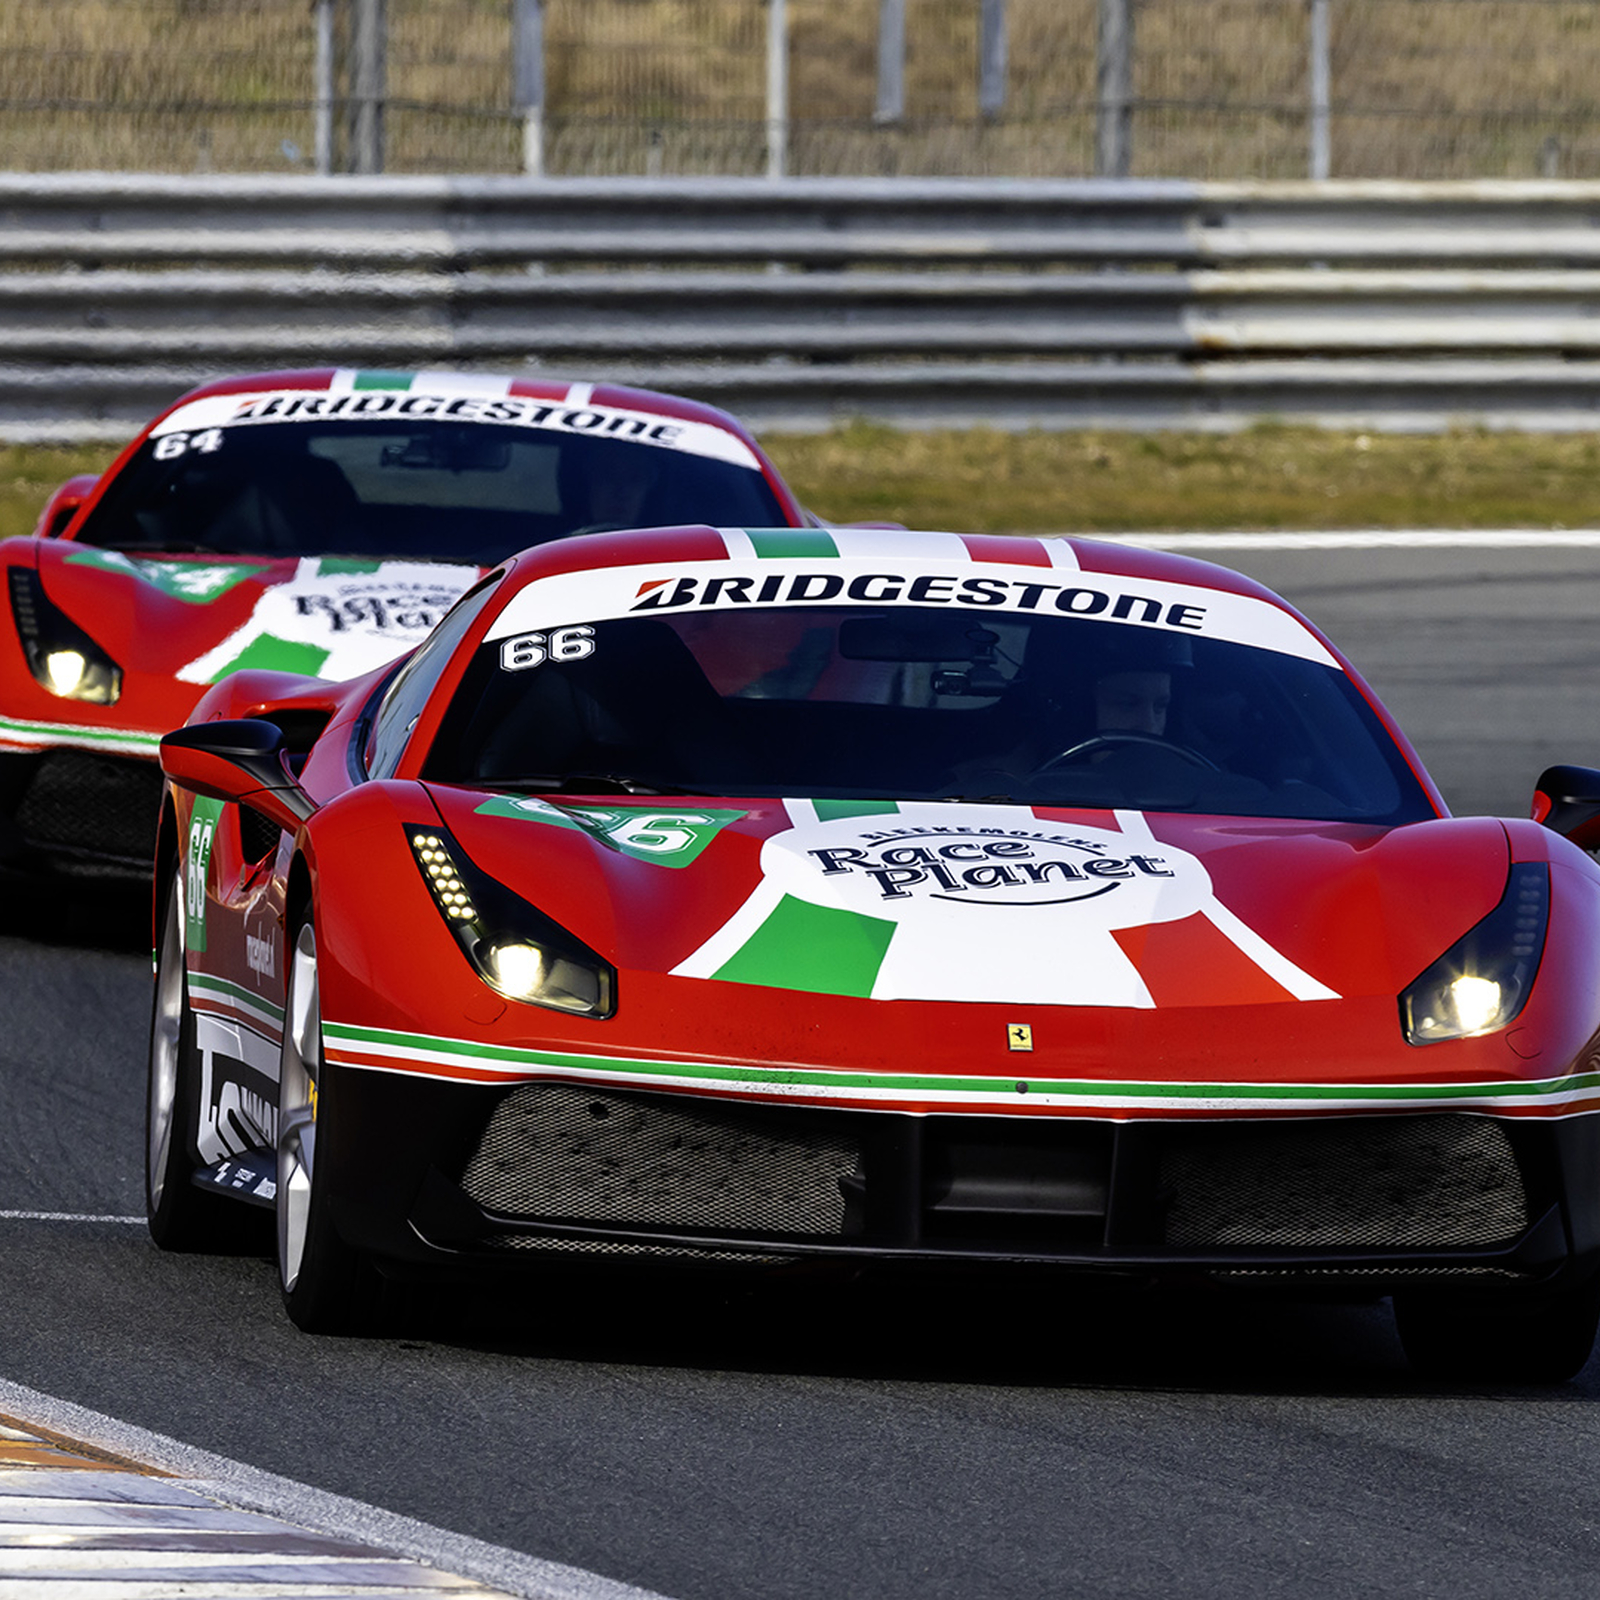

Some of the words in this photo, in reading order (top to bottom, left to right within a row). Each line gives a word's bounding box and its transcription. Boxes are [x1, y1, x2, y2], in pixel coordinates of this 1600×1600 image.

[153, 427, 224, 460] 64
[232, 395, 684, 445] BRIDGESTONE
[629, 573, 1207, 629] BRIDGESTONE
[499, 624, 596, 673] 66
[187, 816, 215, 925] 66
[807, 841, 1035, 876] Race
[865, 854, 1175, 900] Planet
